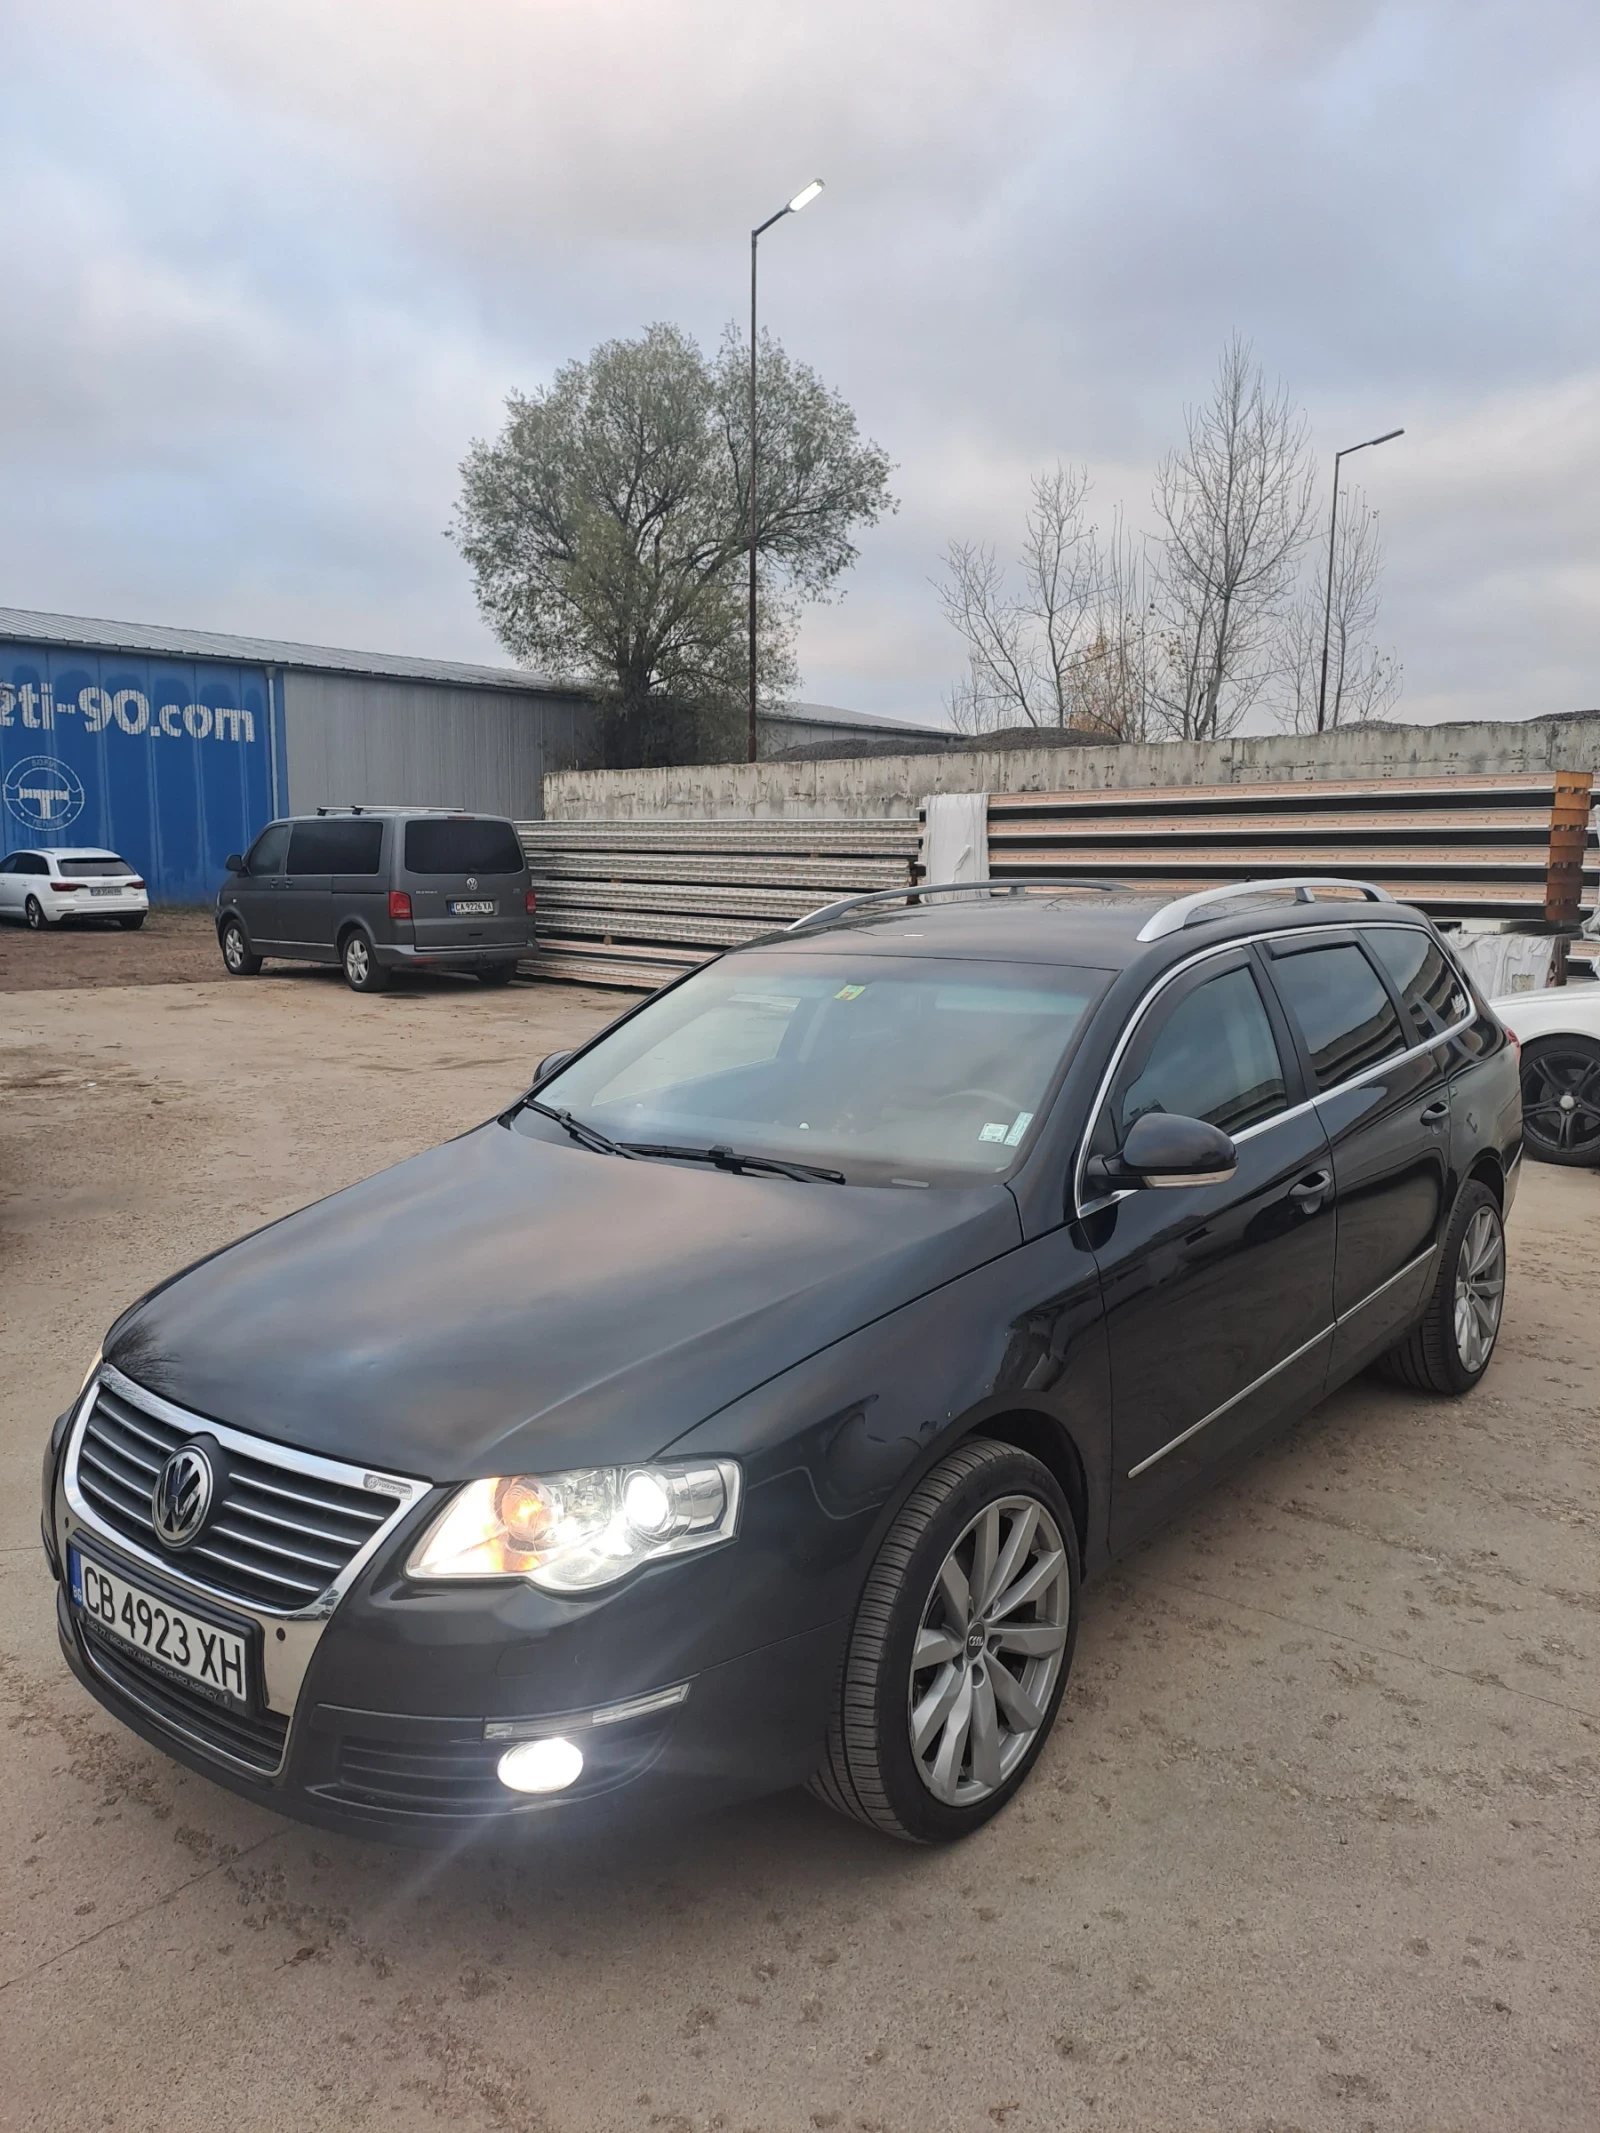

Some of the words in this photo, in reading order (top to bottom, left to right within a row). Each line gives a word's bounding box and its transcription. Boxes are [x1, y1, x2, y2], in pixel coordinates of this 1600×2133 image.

[73, 1584, 82, 1602] BG
[84, 1566, 116, 1624] CB
[121, 1591, 190, 1666] 4923
[197, 1626, 242, 1695] XH
[109, 1634, 137, 1656] SECURITY
